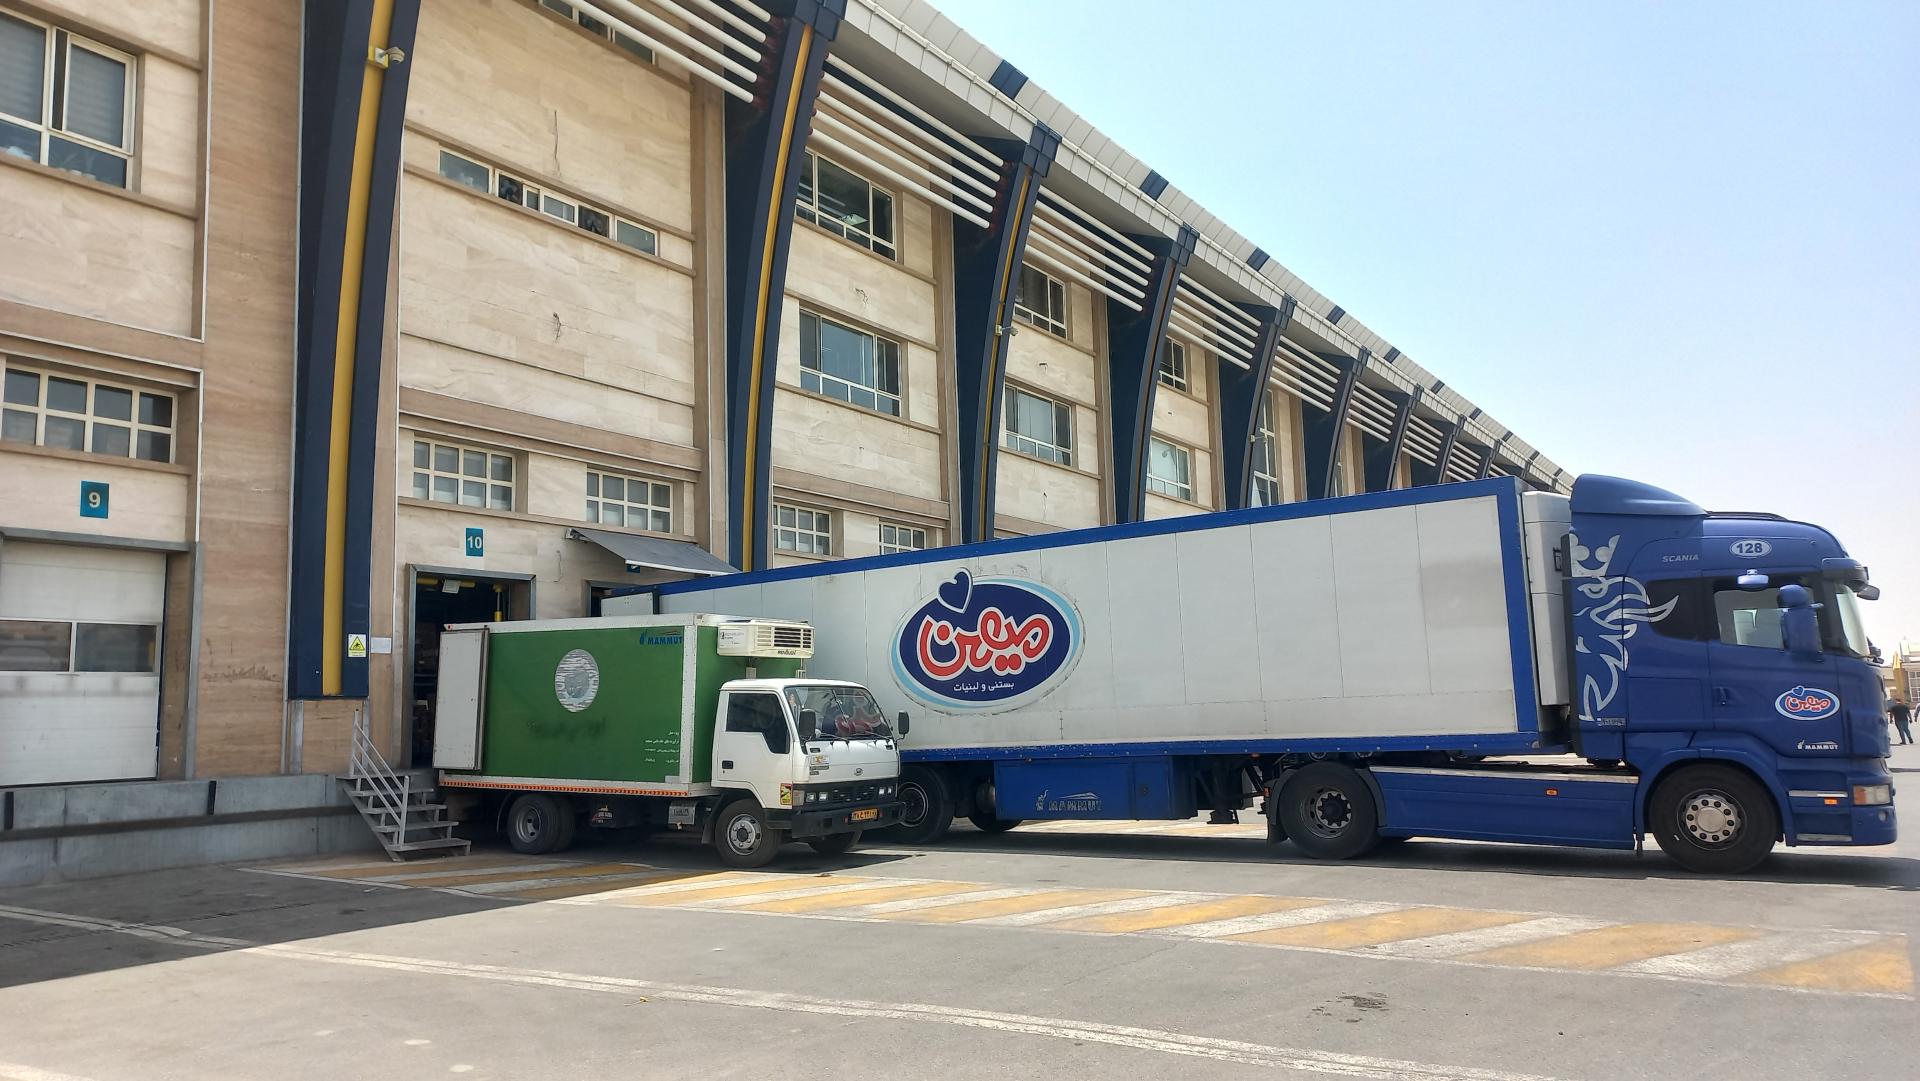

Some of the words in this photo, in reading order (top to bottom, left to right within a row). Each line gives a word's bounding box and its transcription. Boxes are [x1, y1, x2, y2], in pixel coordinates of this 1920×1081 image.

[89, 492, 100, 508] 9
[467, 536, 482, 549] 10
[1736, 543, 1763, 554] 128
[1662, 554, 1699, 563] SCANIA
[647, 635, 683, 645] MAMMUT
[917, 607, 1053, 680] میهن
[953, 682, 979, 693] لبنیات
[981, 683, 986, 692] و
[988, 681, 1015, 692] بستنی
[1785, 696, 1831, 712] میهن
